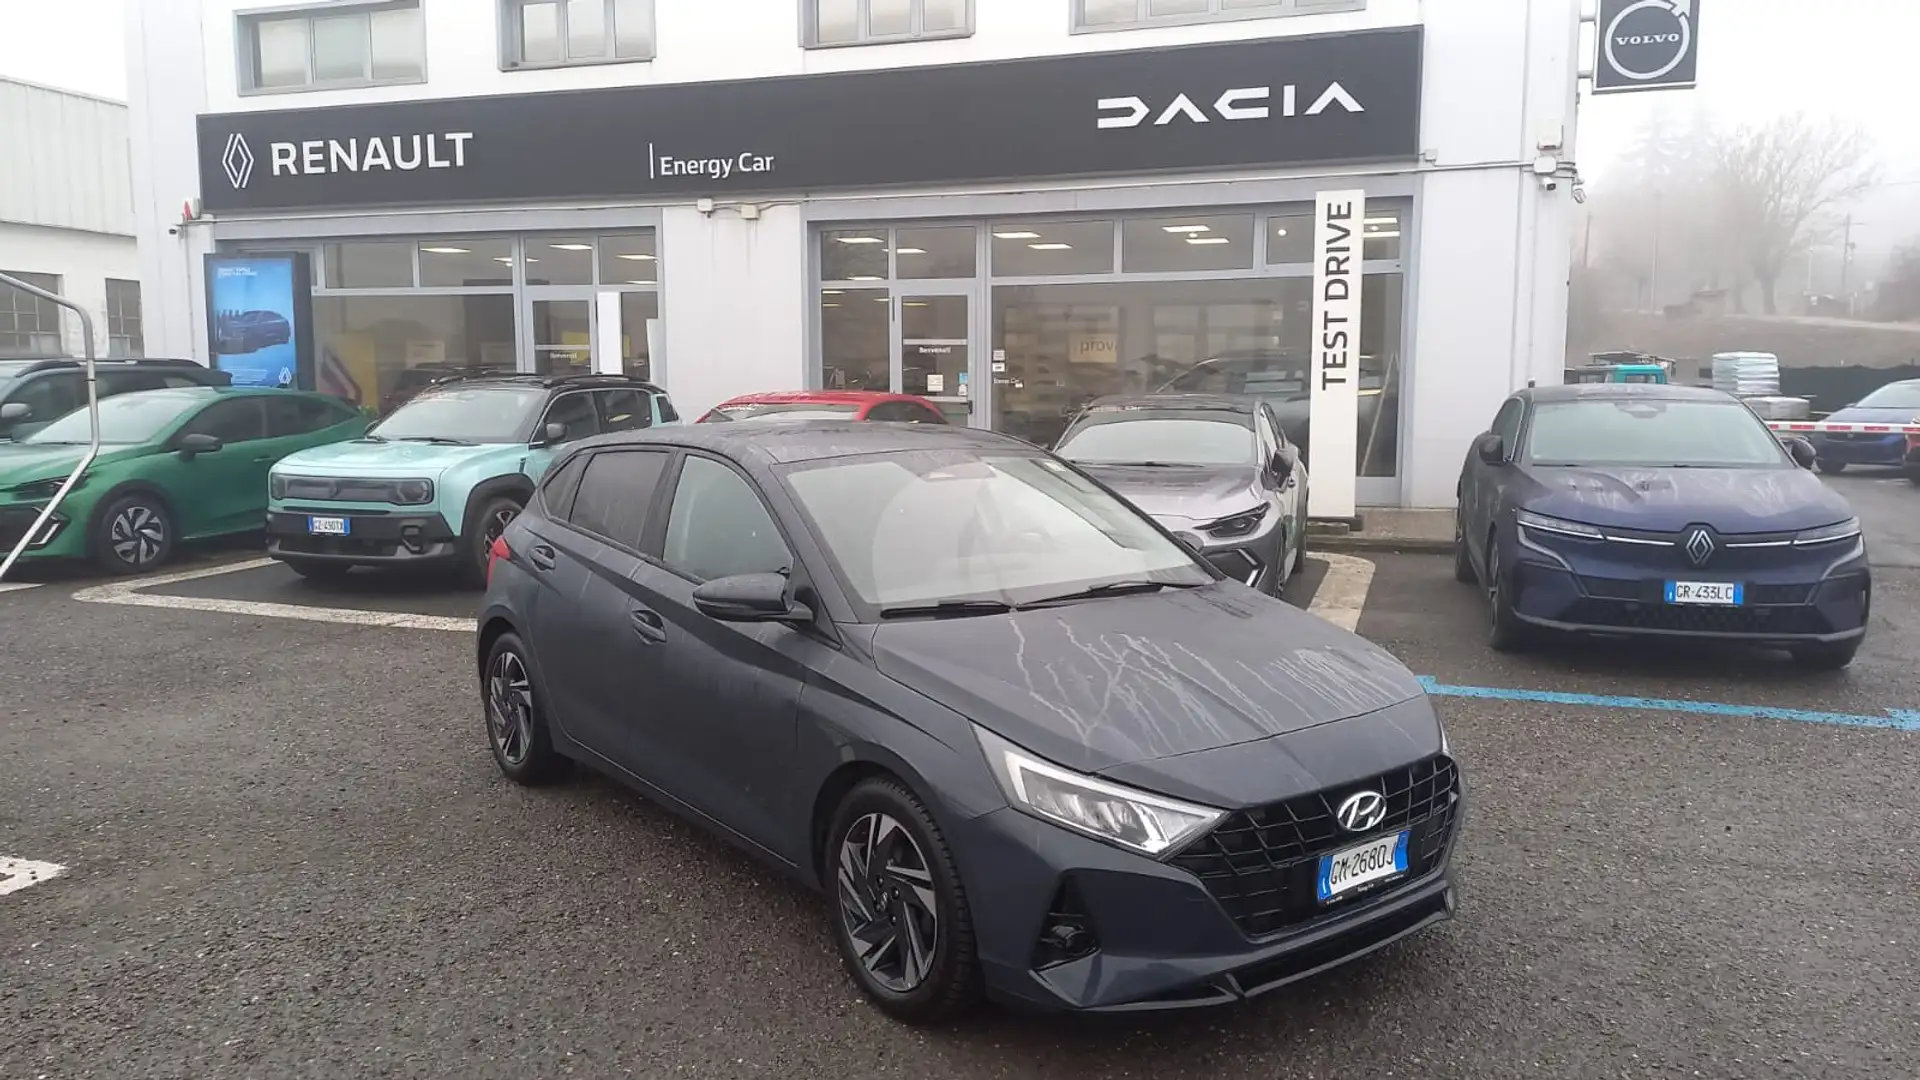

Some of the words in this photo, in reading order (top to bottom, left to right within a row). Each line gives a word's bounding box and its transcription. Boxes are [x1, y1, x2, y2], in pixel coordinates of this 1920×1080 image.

[1614, 33, 1679, 46] VOLVO
[1097, 81, 1365, 129] DACIA
[270, 132, 473, 176] RENAULT
[660, 156, 734, 179] Energy
[738, 152, 775, 172] Car
[1325, 201, 1352, 302] DRIVE
[1322, 310, 1348, 391] TEST
